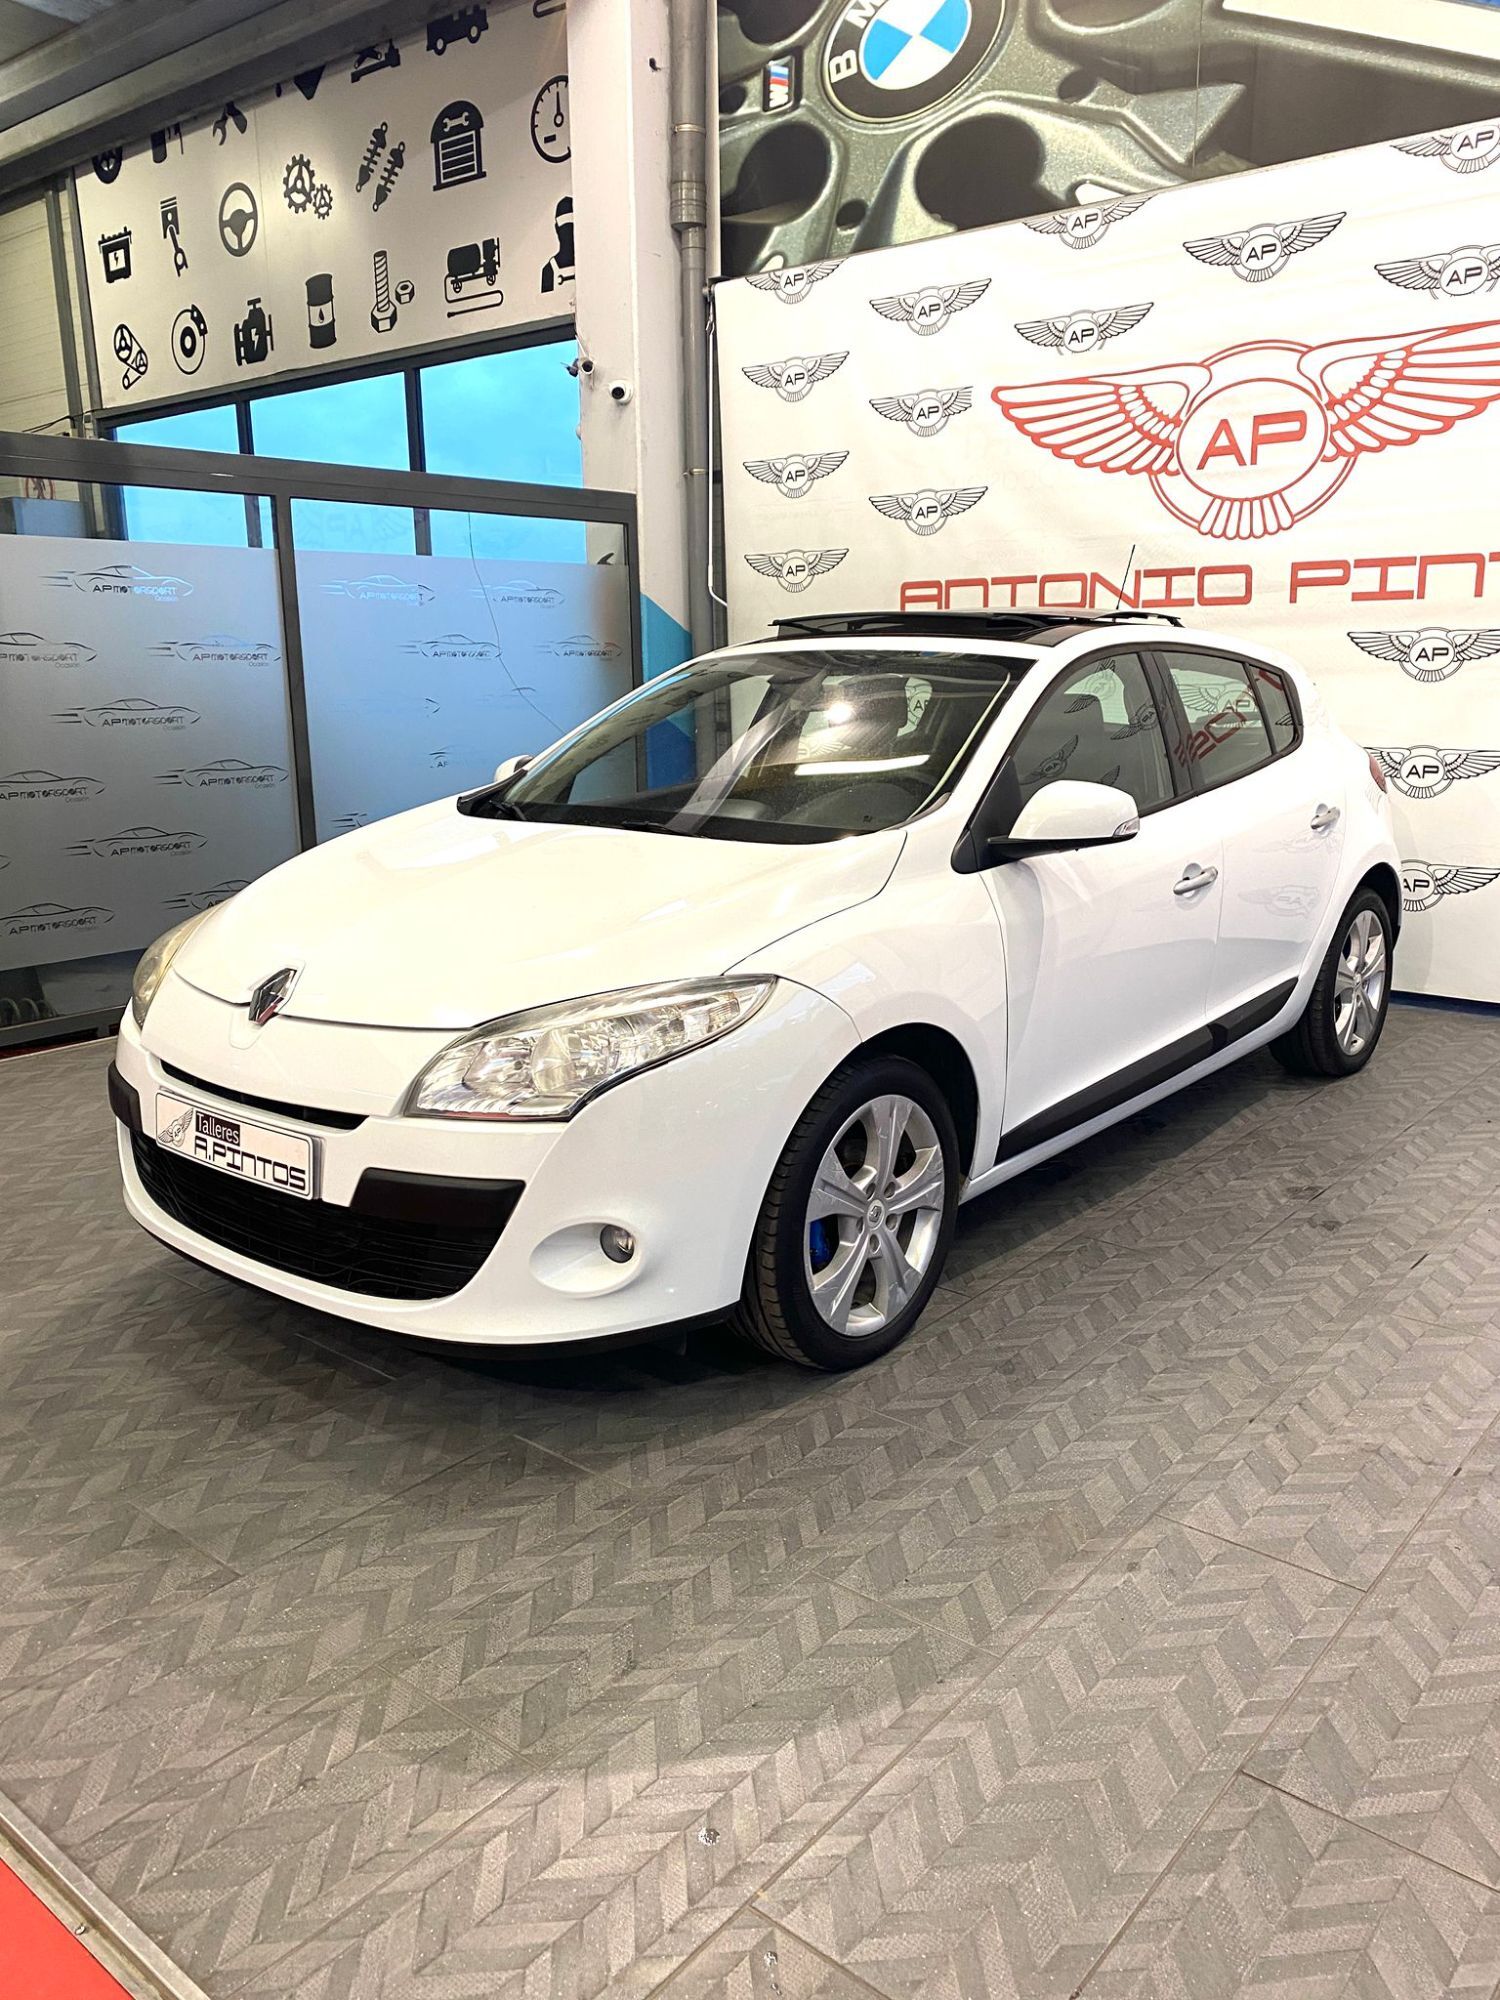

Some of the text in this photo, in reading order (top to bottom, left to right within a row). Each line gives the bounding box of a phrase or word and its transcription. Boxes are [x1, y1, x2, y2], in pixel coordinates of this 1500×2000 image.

[1455, 130, 1496, 150] AP
[1071, 212, 1099, 230] AP
[1245, 243, 1277, 261] AP
[784, 273, 804, 288] AP
[1446, 265, 1483, 286] AP
[917, 303, 941, 319] AP
[1068, 327, 1096, 344] AP
[785, 372, 805, 386] AP
[916, 405, 940, 420] AP
[1197, 409, 1307, 471] AP
[785, 469, 806, 482] AP
[915, 505, 938, 519] AP
[785, 564, 806, 577] AP
[900, 551, 1500, 611] ANTONIO PIN
[1414, 646, 1449, 662] AP
[1405, 764, 1440, 779] AP
[196, 1113, 240, 1144] Talleres
[194, 1135, 306, 1191] A.PINTOS
